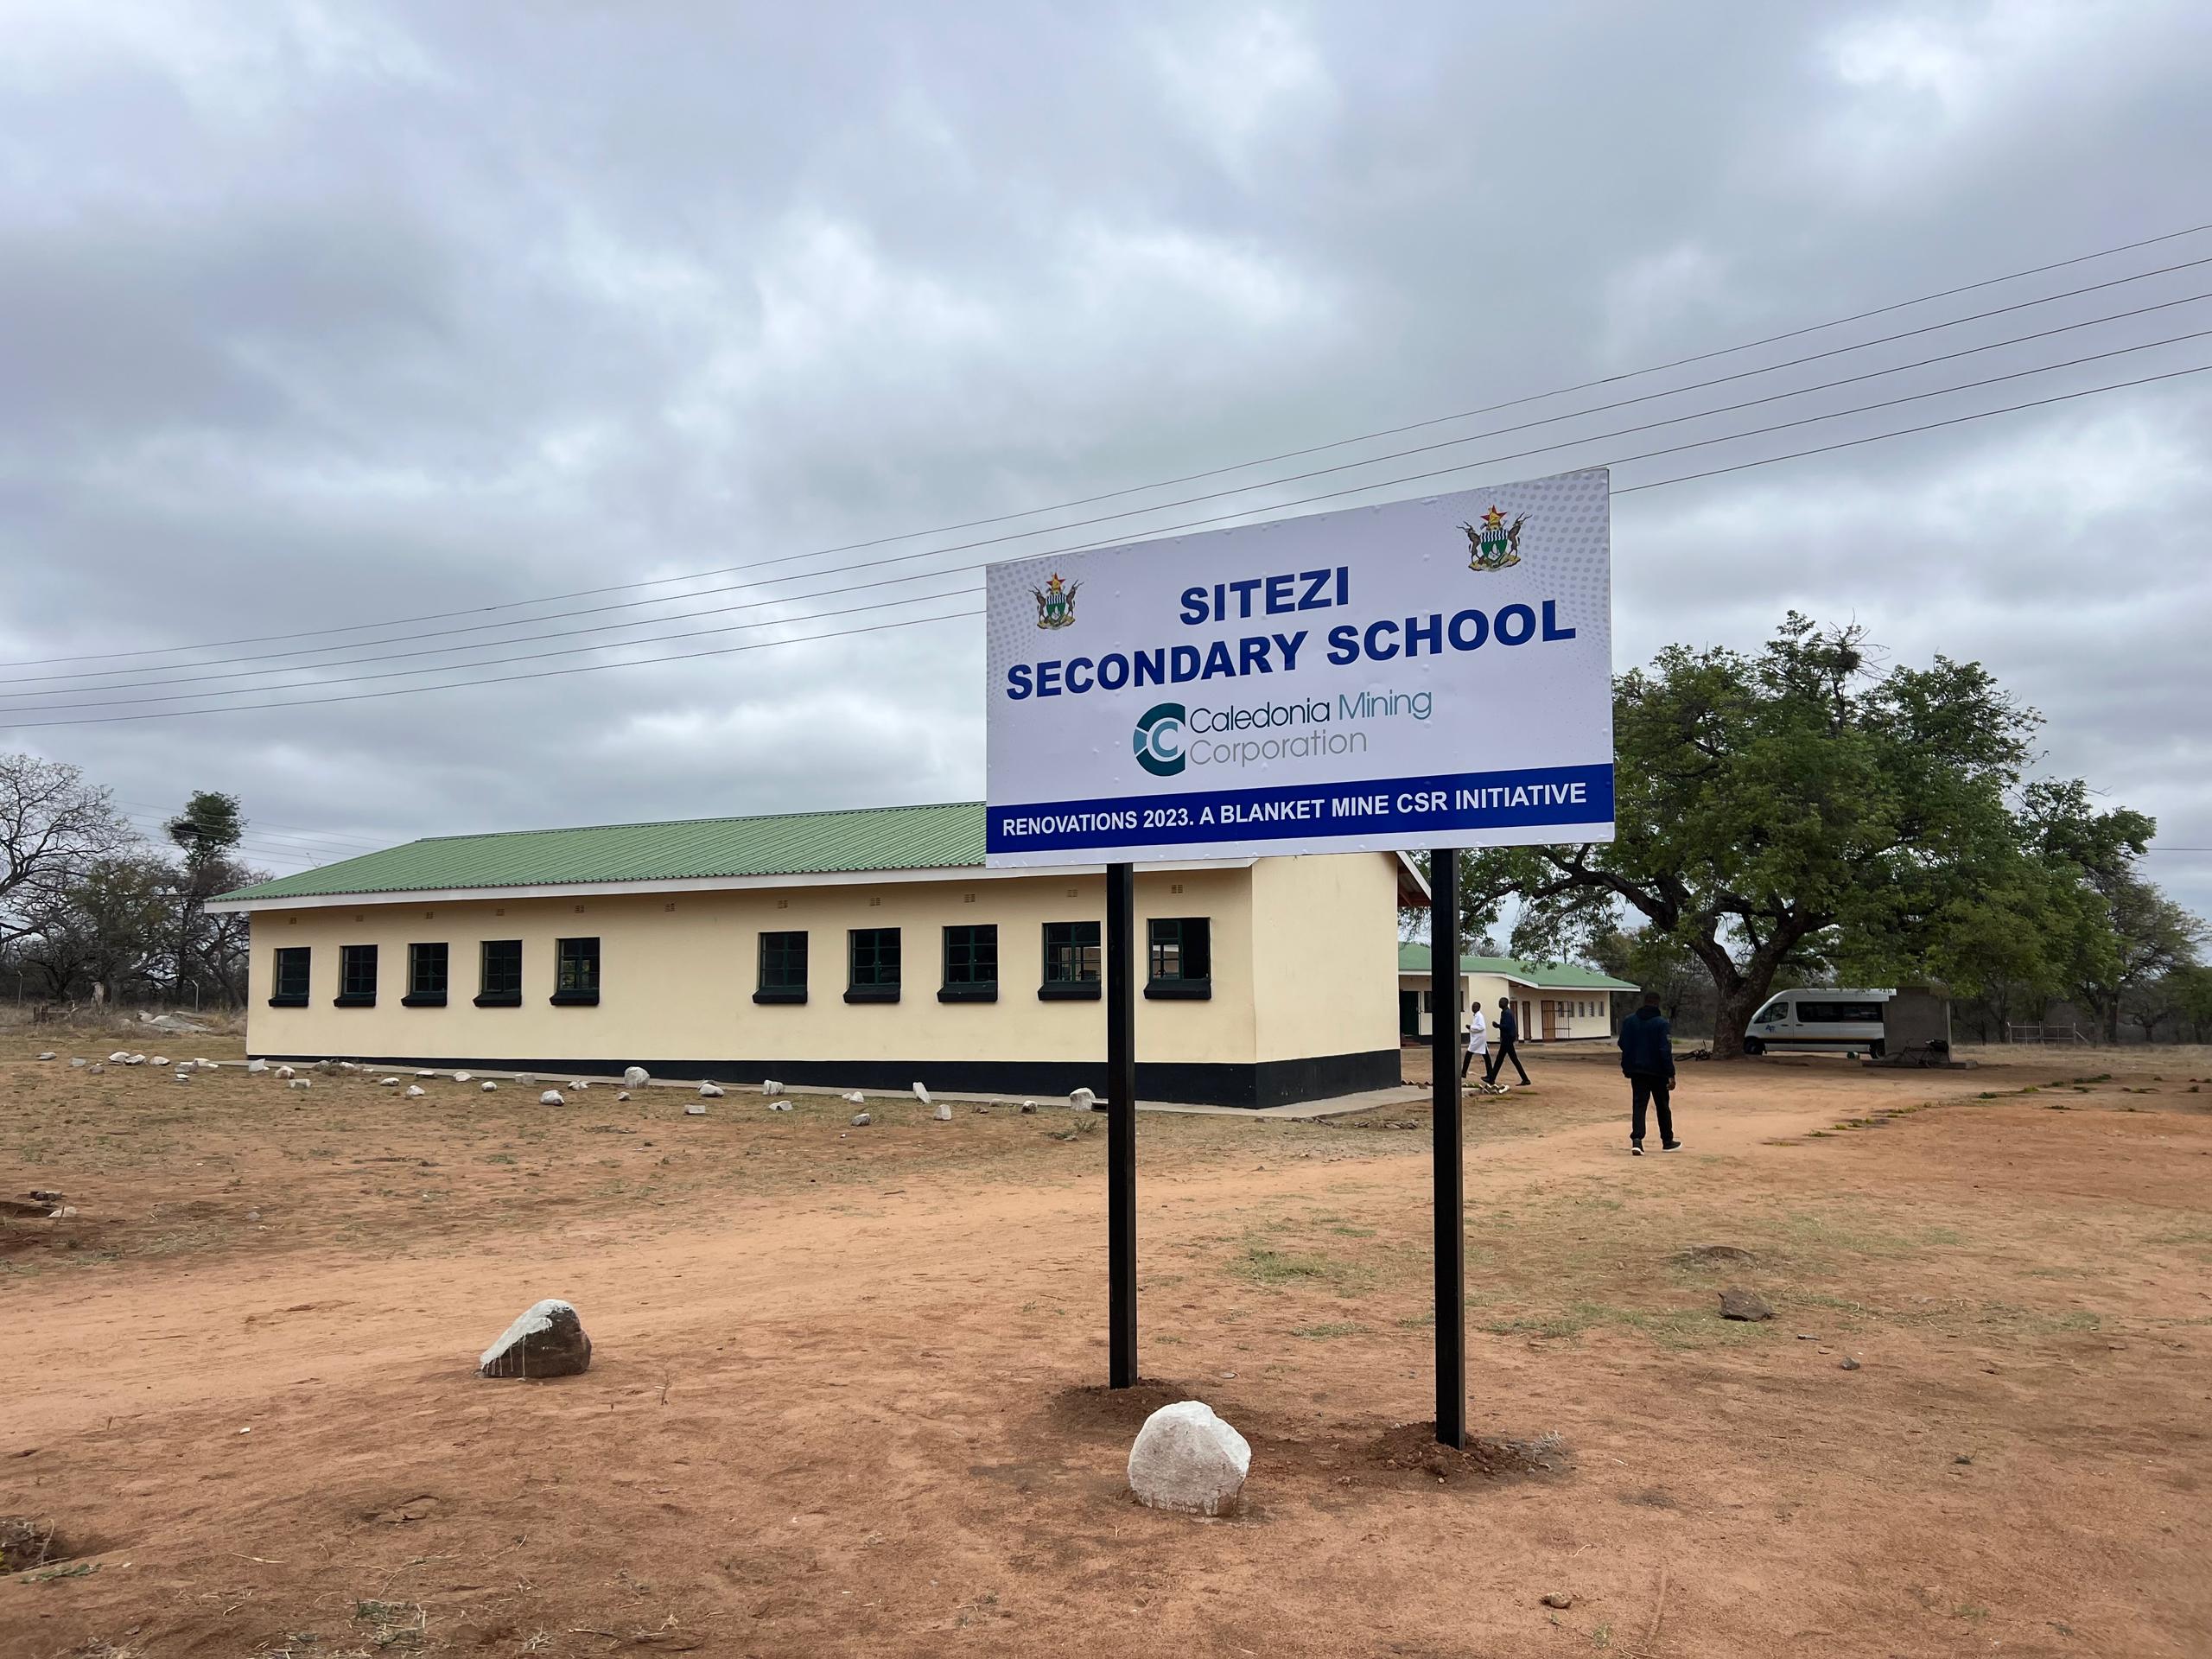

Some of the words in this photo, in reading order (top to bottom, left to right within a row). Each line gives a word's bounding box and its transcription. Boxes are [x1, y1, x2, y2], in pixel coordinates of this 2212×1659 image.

[1179, 565, 1349, 626] SITEZI
[1006, 630, 1309, 701] SECONDARY
[1326, 599, 1577, 666] SCHOOL
[1189, 696, 1331, 734] Caledonia
[1338, 689, 1432, 721] Mining
[1189, 728, 1367, 767] Corporation
[1002, 810, 1138, 836] RENOVATIONS
[1142, 807, 1194, 829] 2023.
[1198, 806, 1216, 825] A
[1220, 798, 1325, 824] BLANKET
[1332, 794, 1389, 817] MINE
[1396, 791, 1449, 814] CSR
[1455, 782, 1587, 810] INITIATIVE
